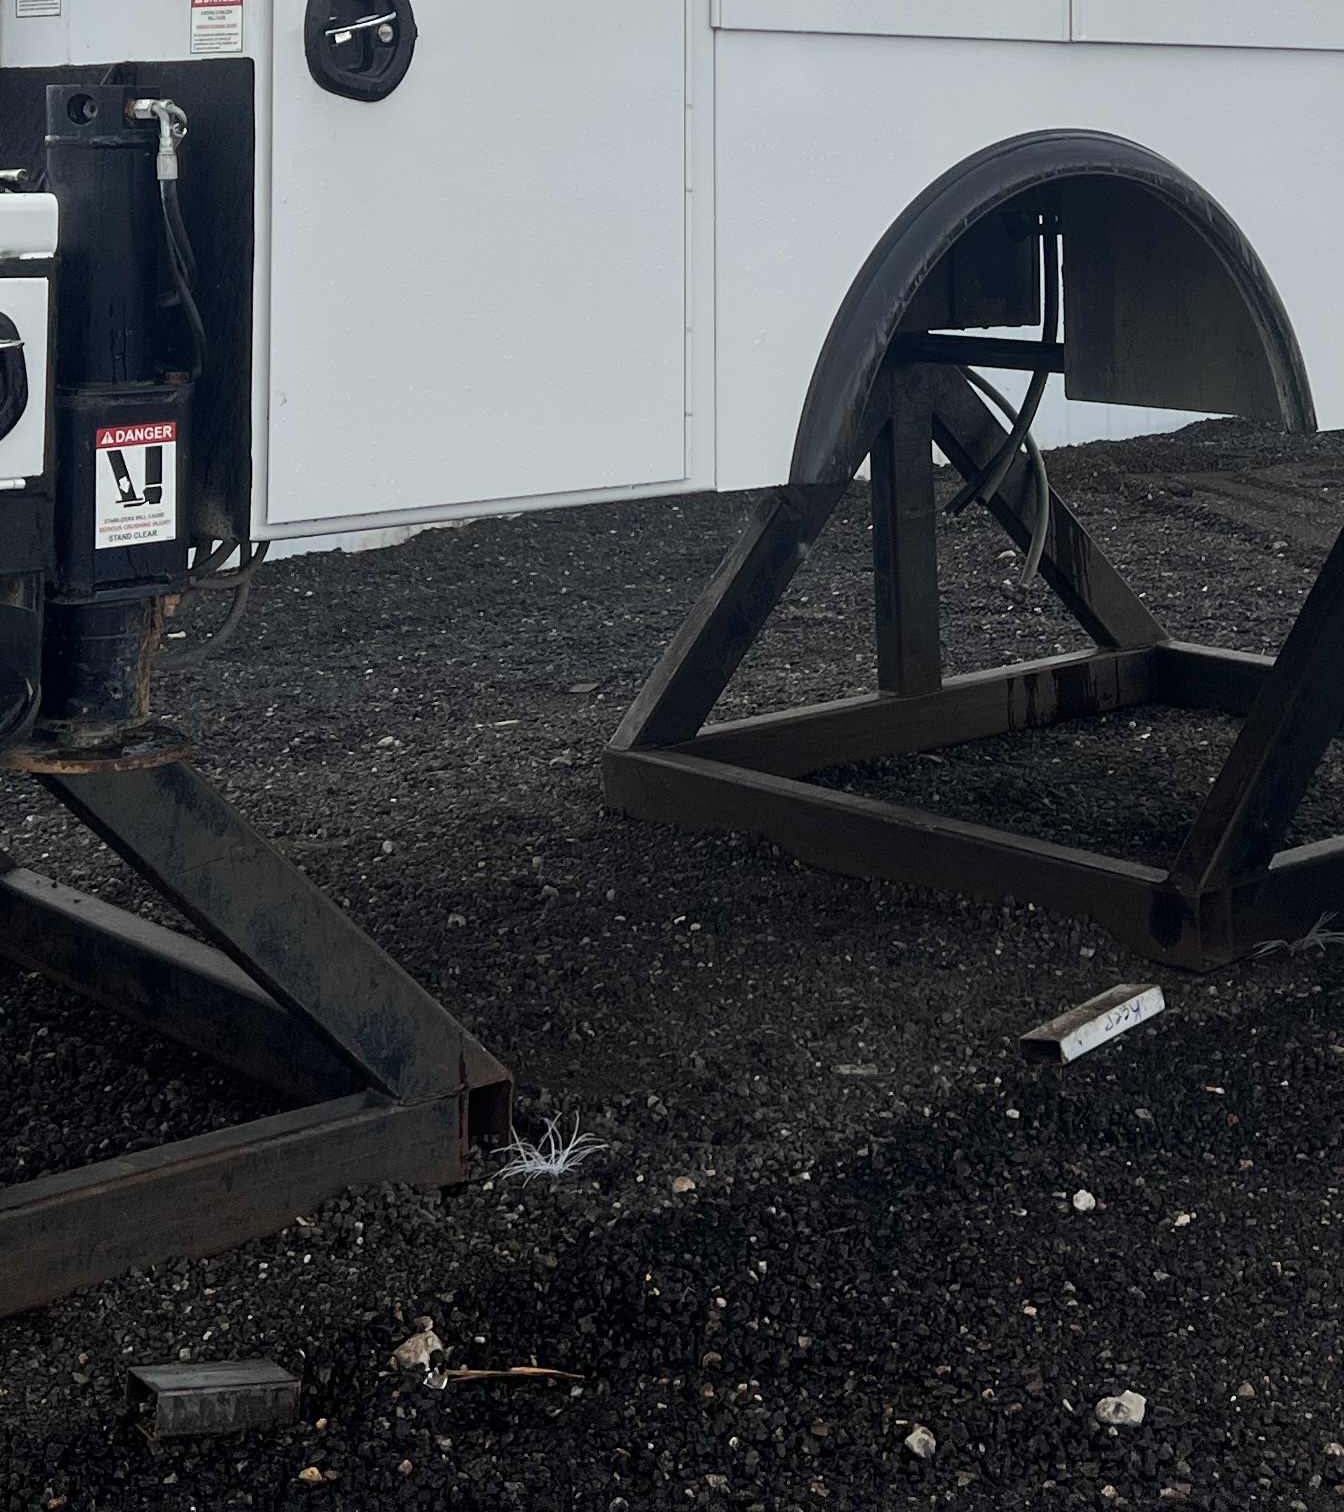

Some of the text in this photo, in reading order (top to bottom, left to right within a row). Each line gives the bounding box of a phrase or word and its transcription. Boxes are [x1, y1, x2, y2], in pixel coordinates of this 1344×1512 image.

[116, 425, 172, 442] DANGER
[109, 533, 132, 542] STAND
[134, 530, 157, 539] CLEAR
